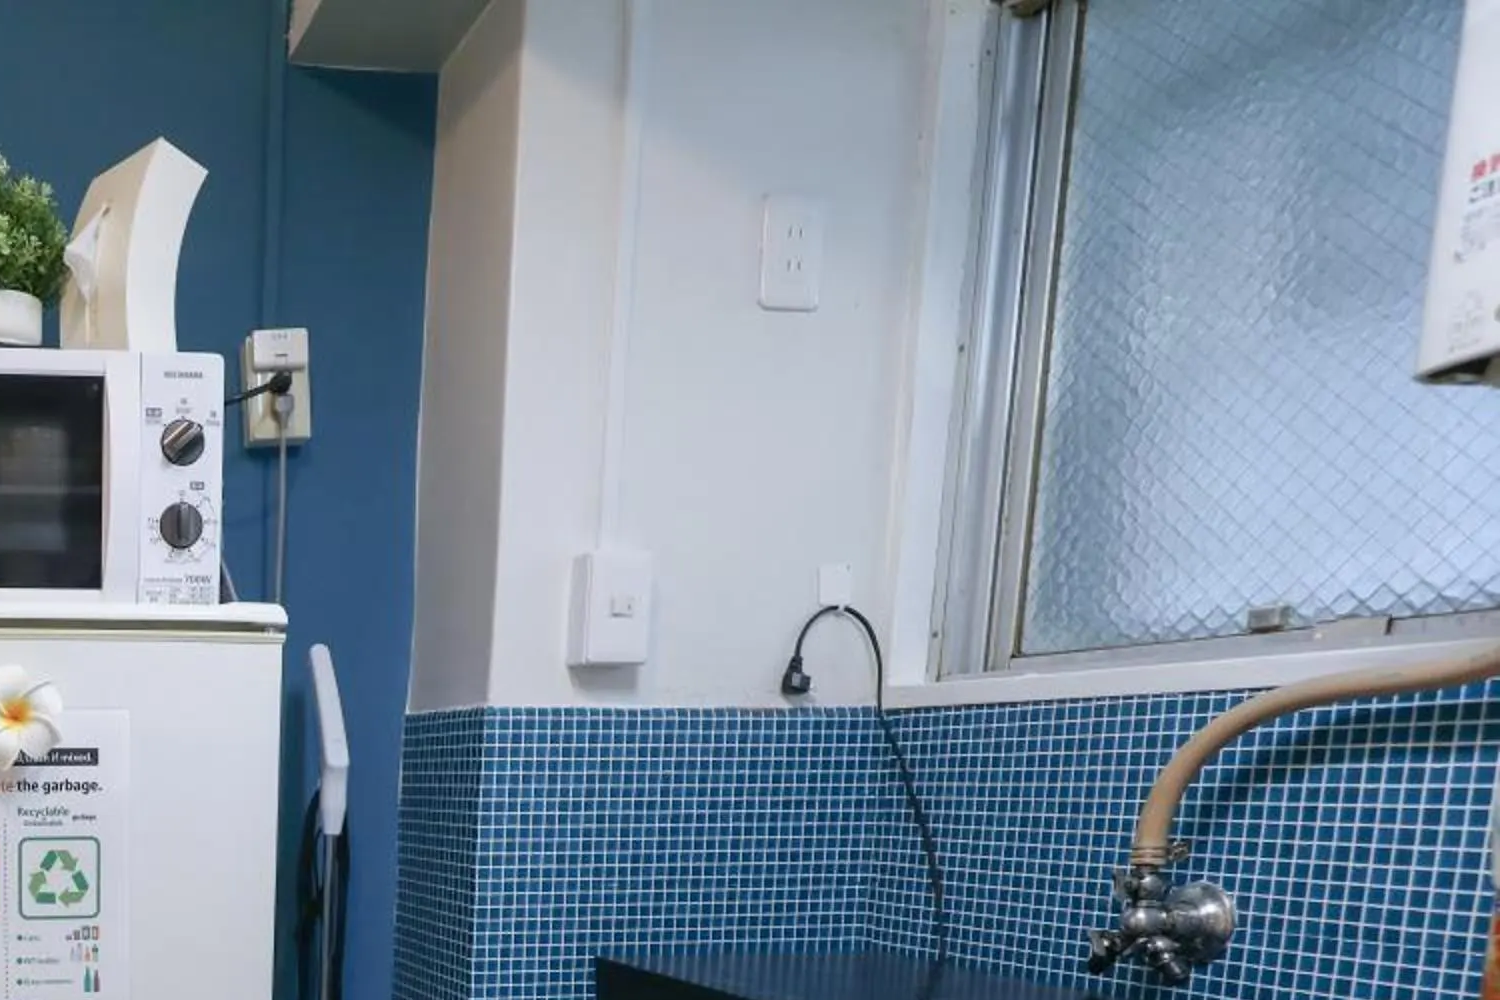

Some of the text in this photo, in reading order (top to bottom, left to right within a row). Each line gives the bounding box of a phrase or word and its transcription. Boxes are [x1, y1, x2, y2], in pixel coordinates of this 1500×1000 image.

[16, 778, 38, 792] the
[42, 778, 103, 795] garbage.
[17, 806, 70, 819] Recyclable
